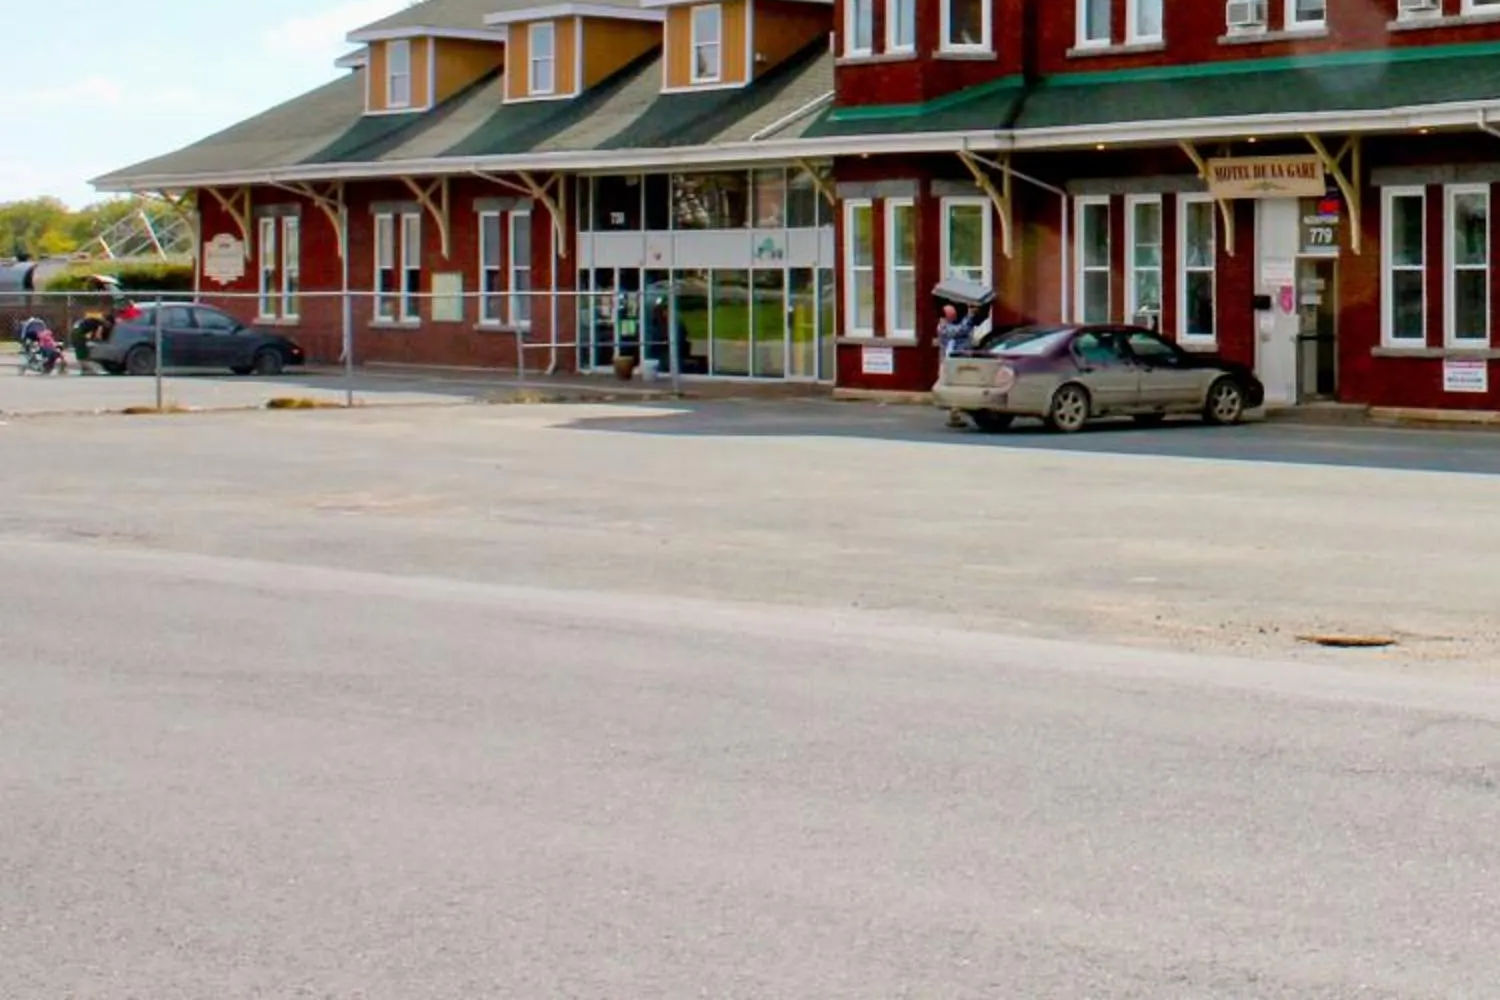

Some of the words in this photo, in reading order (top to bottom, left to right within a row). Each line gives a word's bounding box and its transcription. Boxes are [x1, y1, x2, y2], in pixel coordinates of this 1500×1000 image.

[1214, 165, 1249, 182] MOTEL
[1253, 164, 1266, 179] DE
[1270, 163, 1285, 178] LA
[1286, 161, 1316, 180] GARE
[1309, 227, 1333, 243] 779
